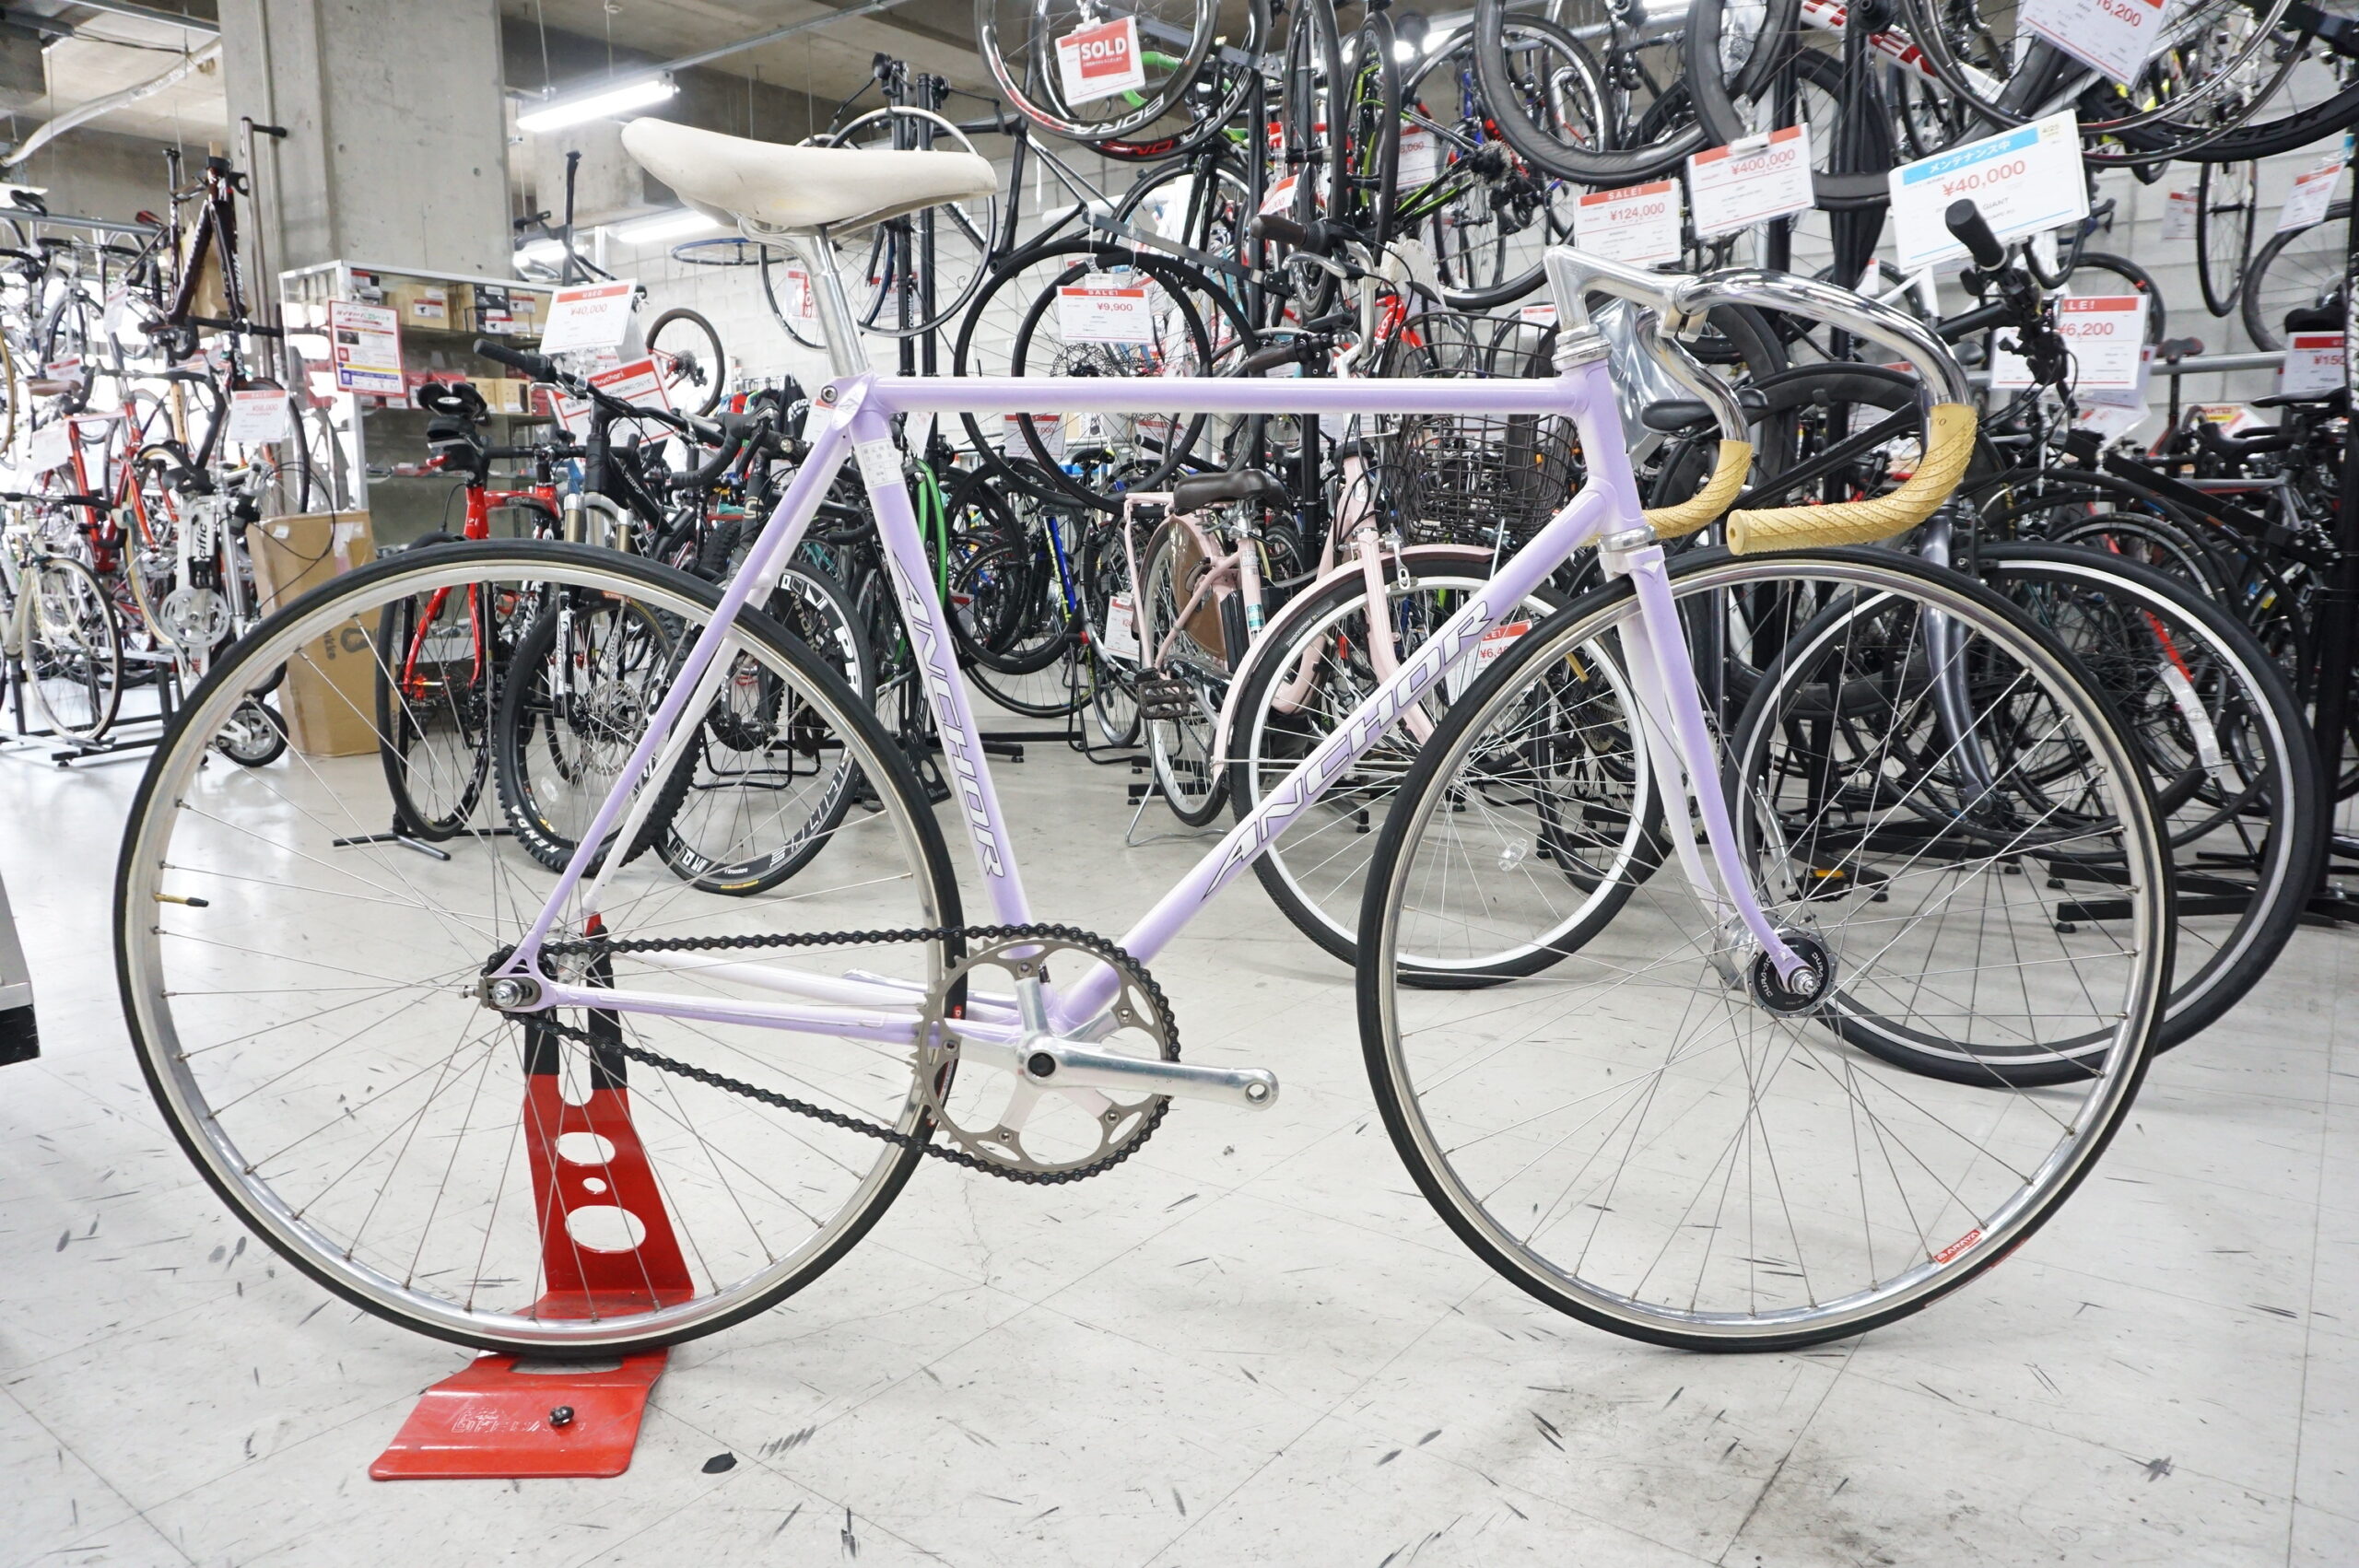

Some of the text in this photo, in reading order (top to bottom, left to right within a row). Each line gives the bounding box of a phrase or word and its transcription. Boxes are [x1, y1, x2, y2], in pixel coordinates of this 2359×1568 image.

[1081, 37, 1127, 61] SOLD
[1073, 93, 1164, 135] BORA
[1179, 66, 1252, 145] BORA
[1731, 148, 1796, 175] ¥400,000
[1929, 139, 2011, 174] メンテナンス中
[1942, 159, 2026, 197] ¥40,000
[1607, 186, 1643, 201] SALE!
[1610, 202, 1666, 221] ¥124,000
[569, 302, 609, 317] ¥40,000
[1096, 302, 1134, 312] ¥9,900
[2063, 299, 2095, 310] LE!
[1285, 617, 1314, 649] BRIDGESTONE
[892, 548, 1006, 879] ANCHOR
[1202, 600, 1494, 900] ANCHOR
[1946, 1231, 1980, 1256] ARAYA
